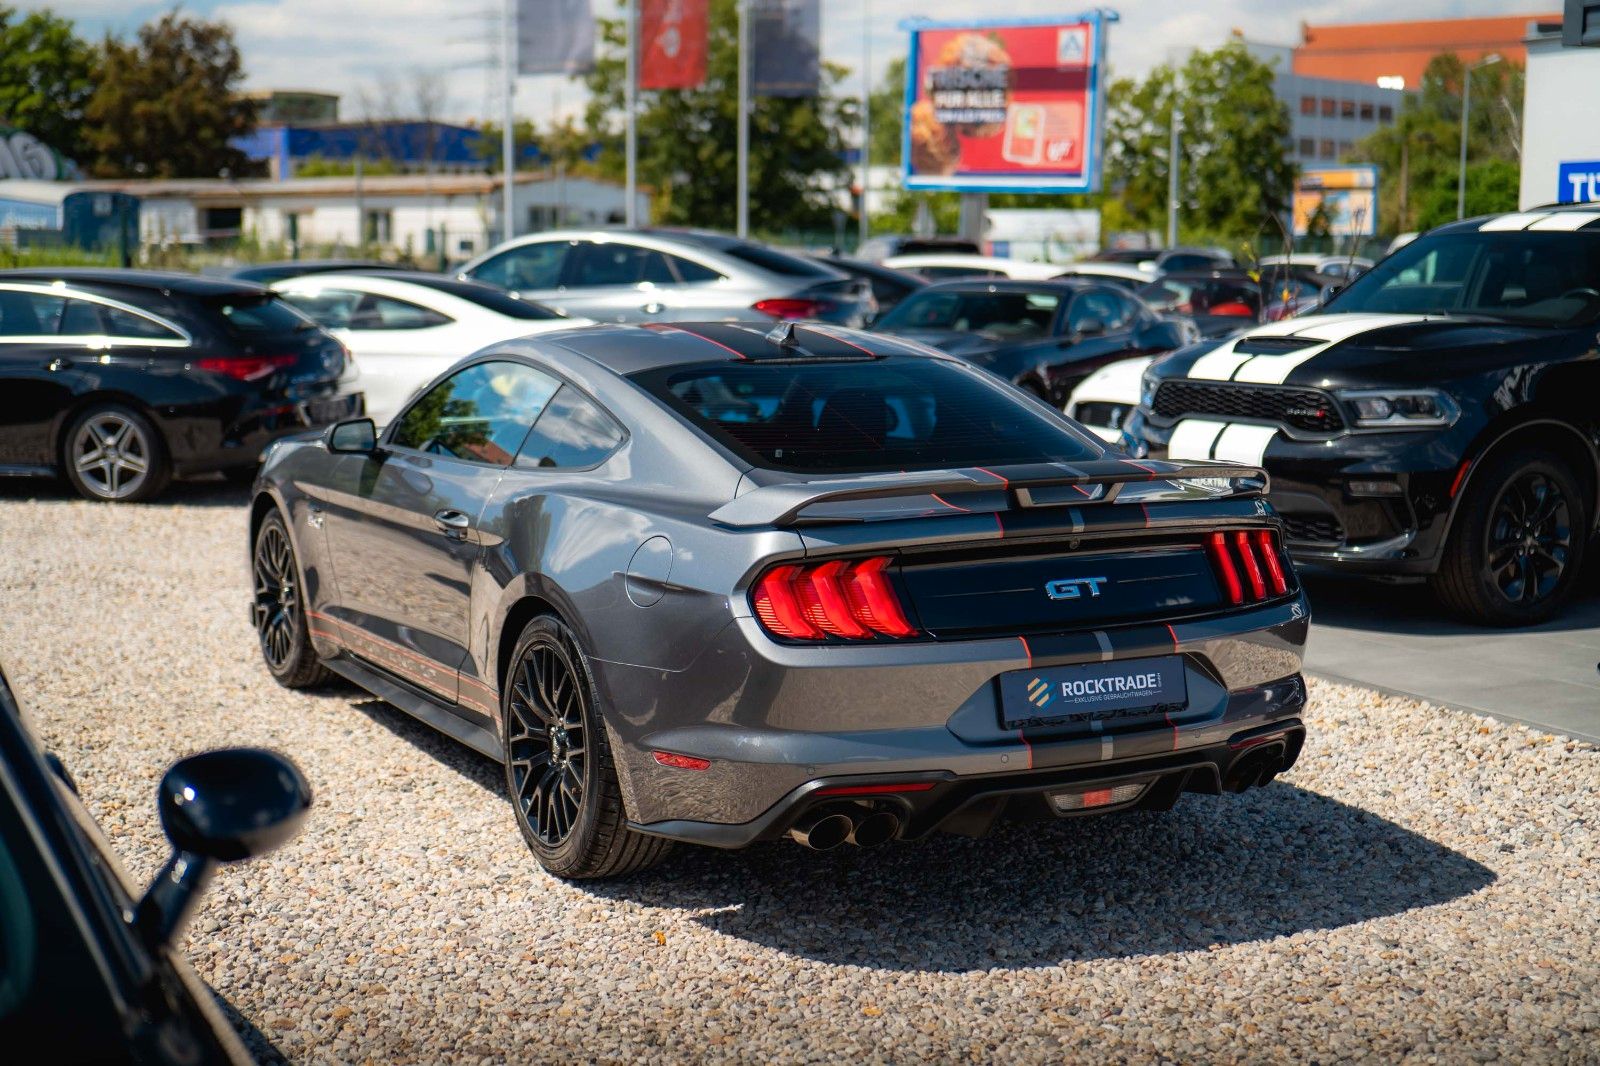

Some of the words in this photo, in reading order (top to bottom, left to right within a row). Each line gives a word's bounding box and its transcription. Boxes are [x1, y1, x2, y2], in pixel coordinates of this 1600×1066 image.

[1045, 576, 1107, 600] GT
[1062, 674, 1157, 697] ROCKTRADE
[1074, 694, 1103, 704] EXKLUSIVE
[1103, 690, 1153, 701] GEBRAUCHTWAGEN
